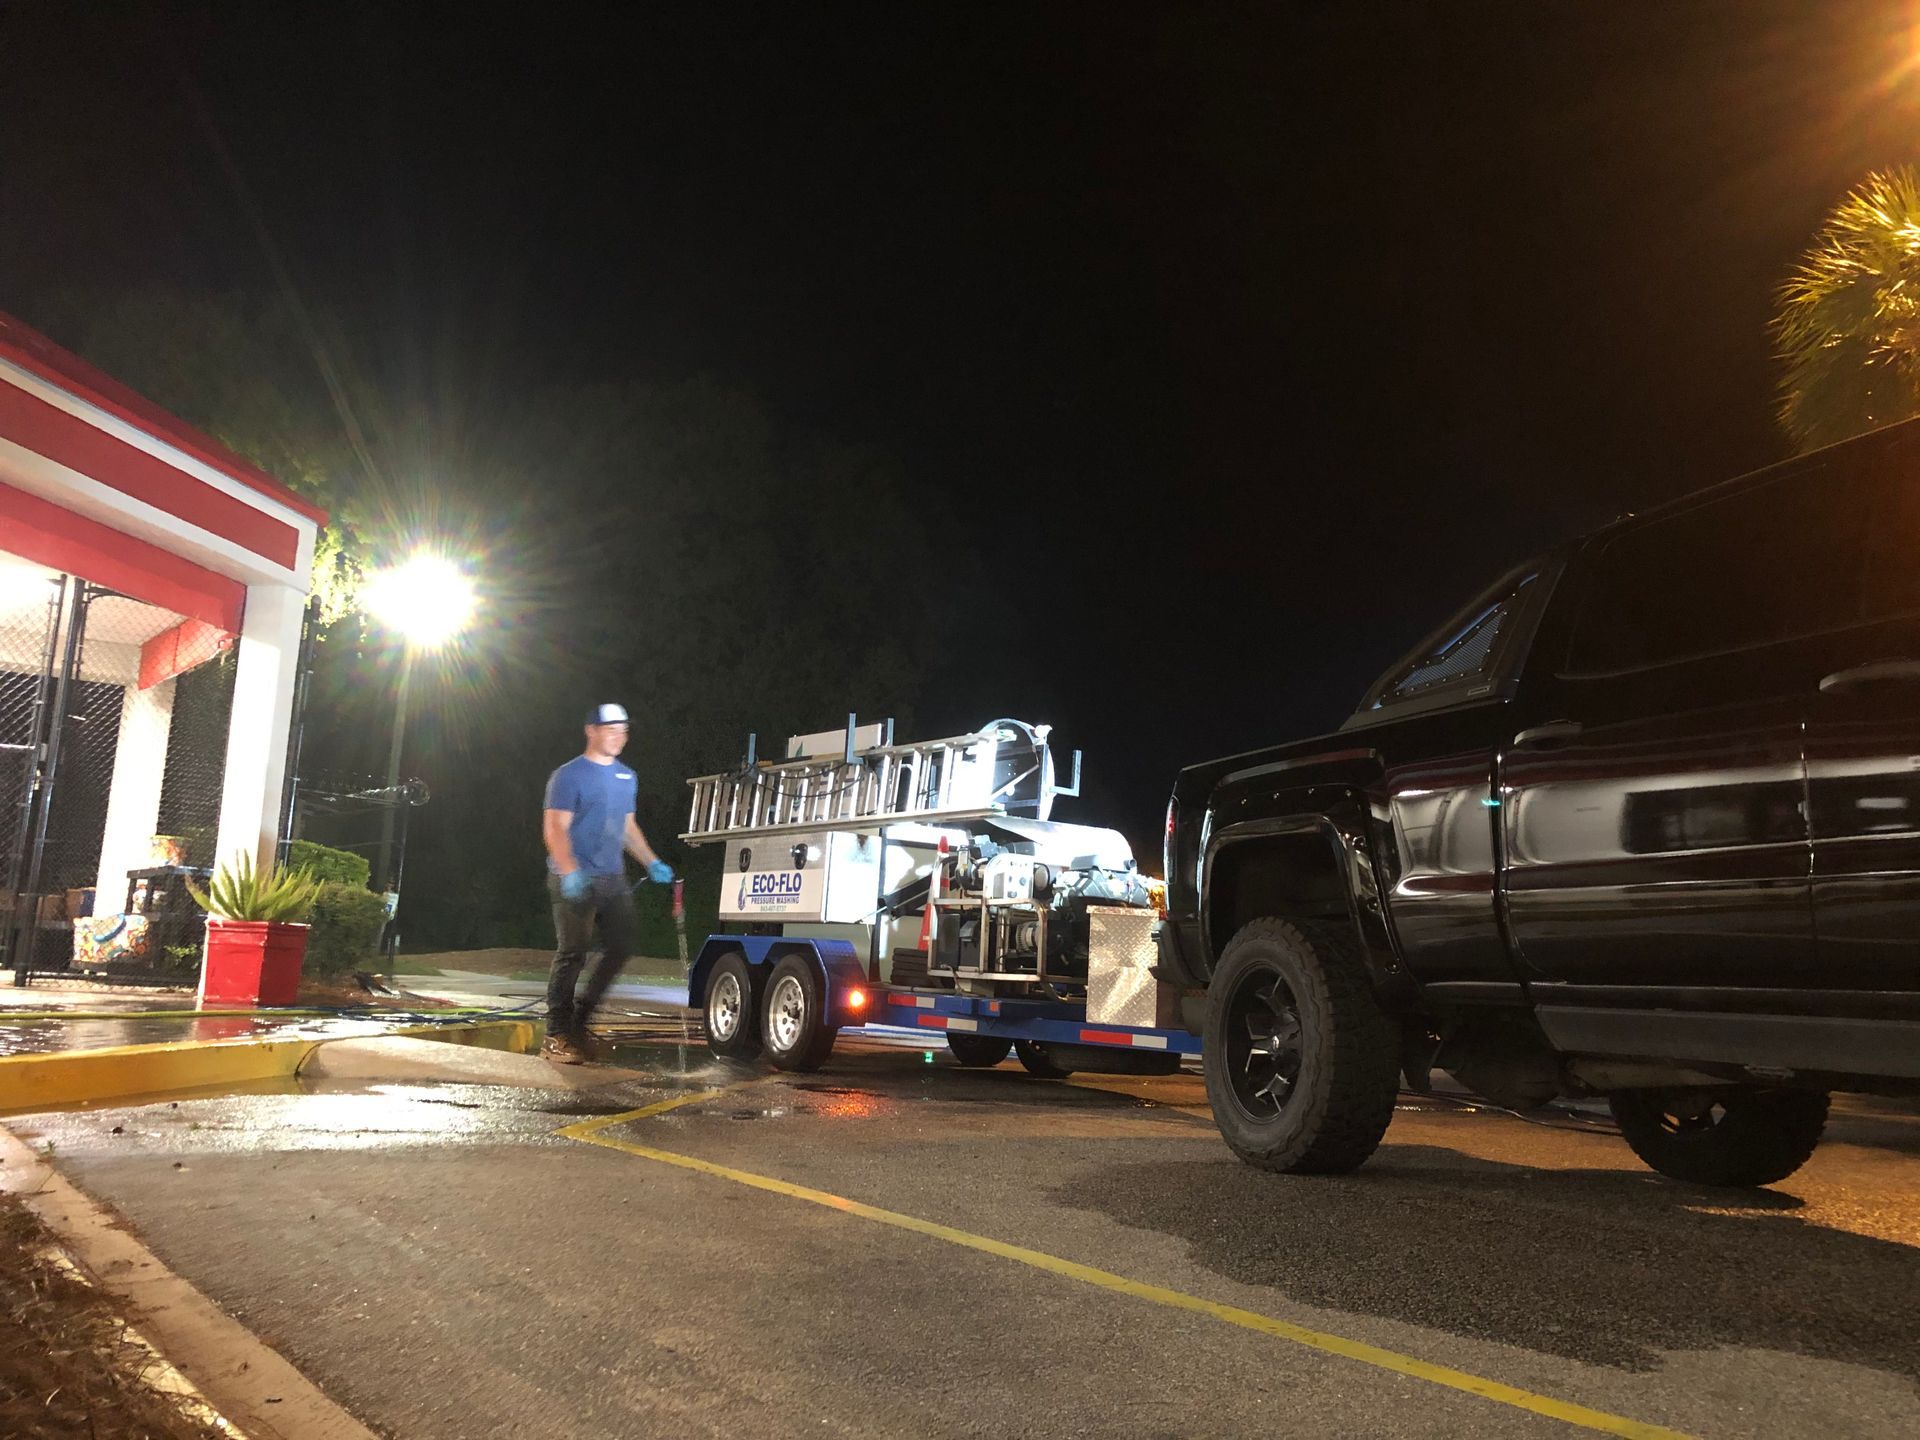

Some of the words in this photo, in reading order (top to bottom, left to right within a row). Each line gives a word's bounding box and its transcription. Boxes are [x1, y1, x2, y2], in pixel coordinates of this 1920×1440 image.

[752, 873, 802, 893] ECO-FLO
[751, 896, 775, 904] PRESSURE
[776, 896, 800, 904] WASHING
